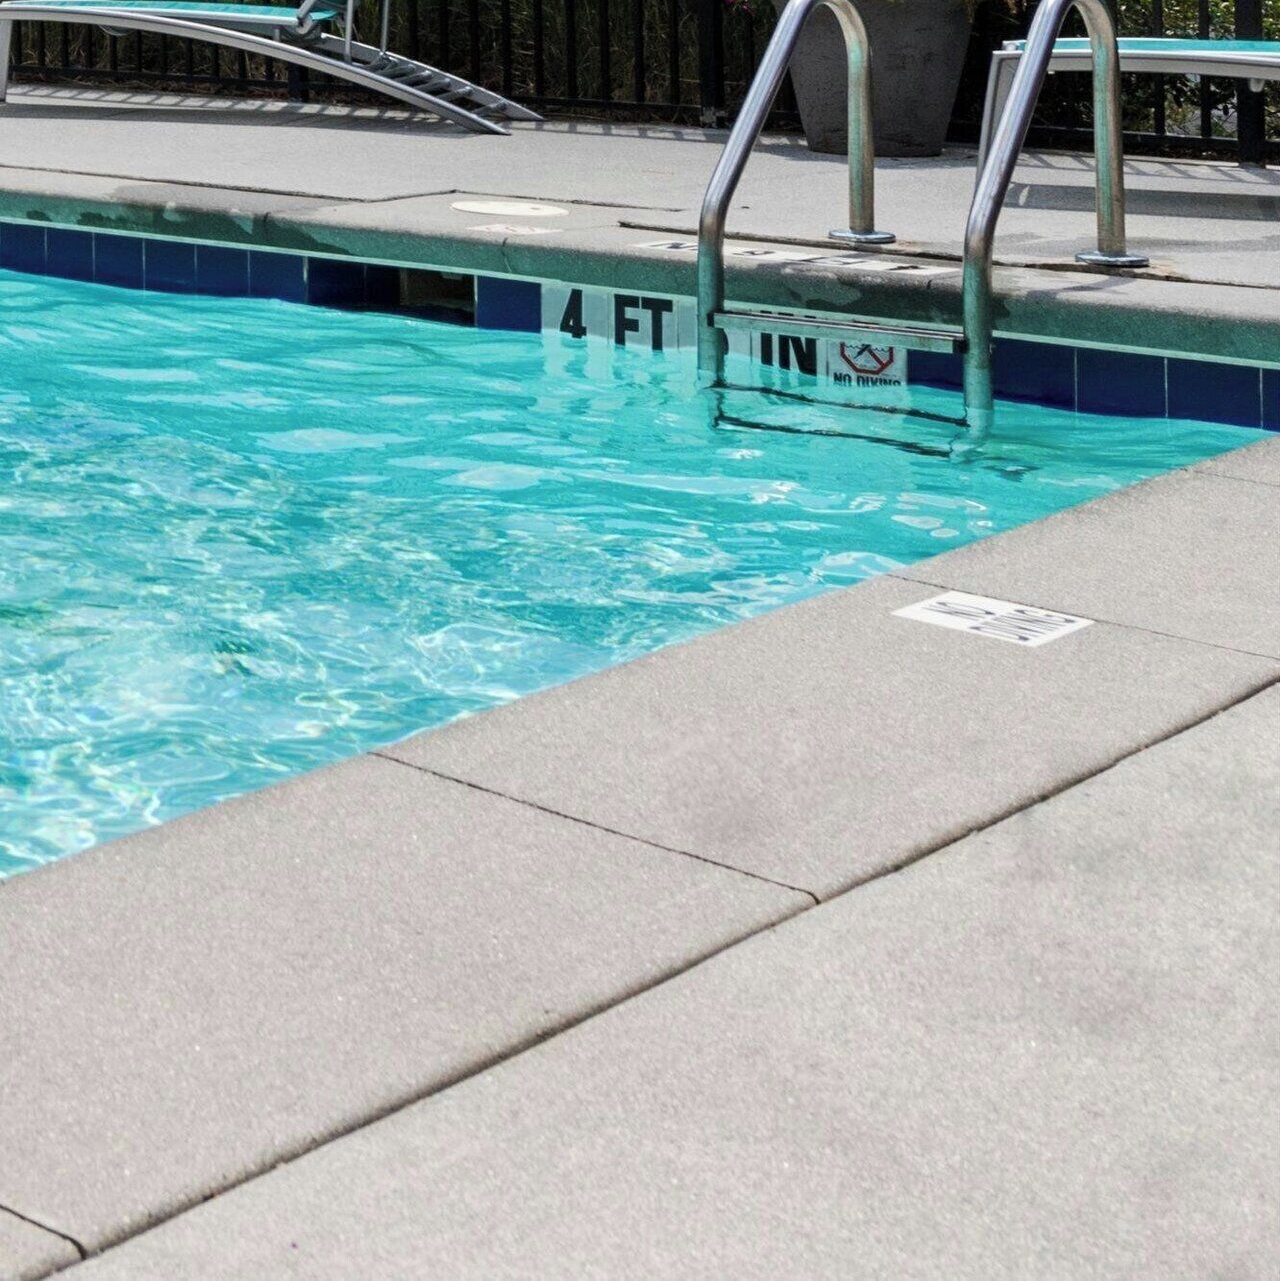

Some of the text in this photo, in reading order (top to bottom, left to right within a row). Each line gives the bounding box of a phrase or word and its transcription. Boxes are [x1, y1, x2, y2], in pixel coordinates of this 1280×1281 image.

[559, 288, 587, 339] 4
[613, 293, 673, 351] FT
[759, 310, 818, 377] IN
